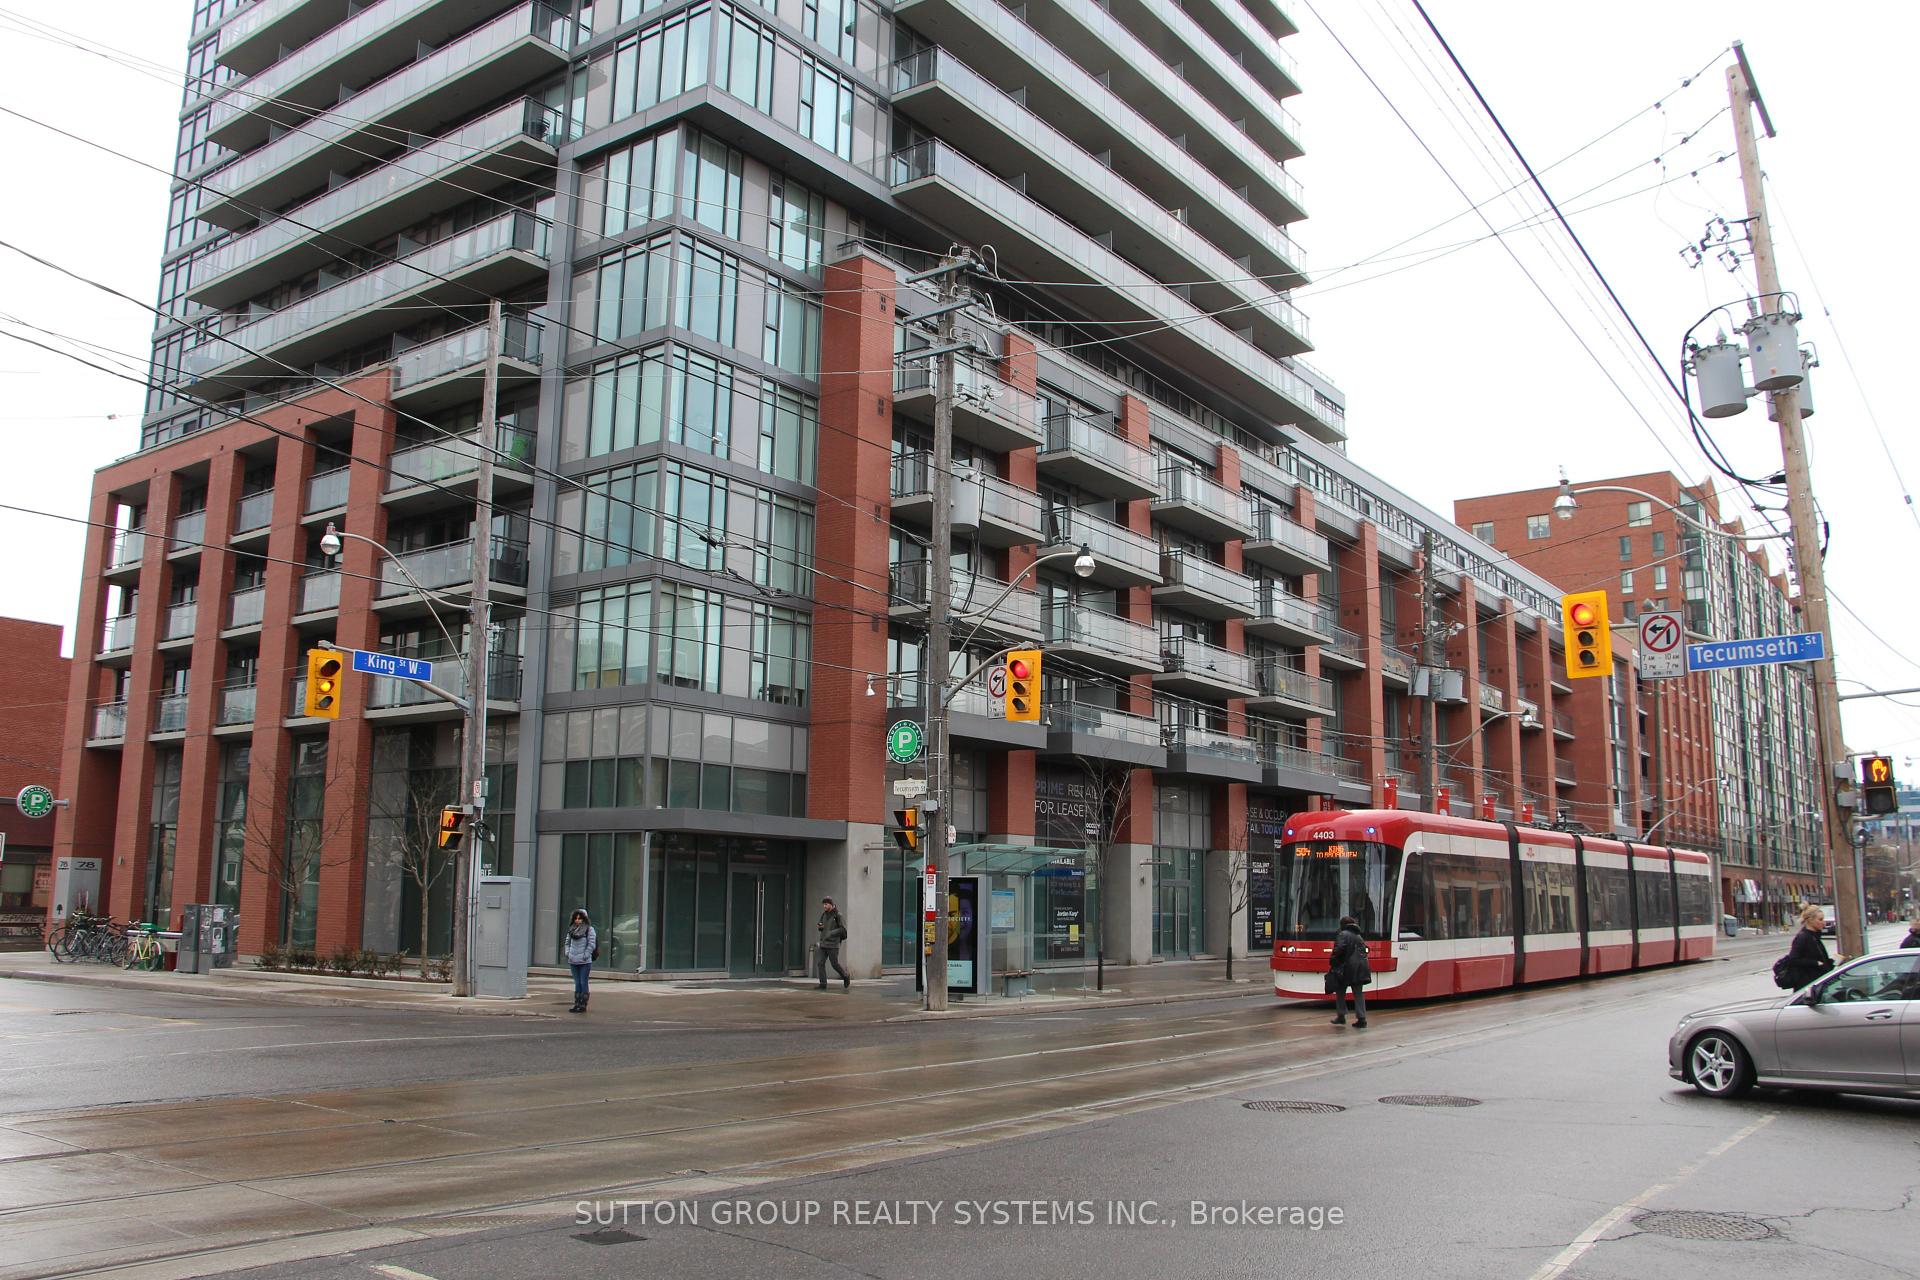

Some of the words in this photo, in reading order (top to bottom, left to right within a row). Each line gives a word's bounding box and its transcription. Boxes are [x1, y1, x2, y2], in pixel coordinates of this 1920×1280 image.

[1694, 638, 1798, 663] Tecumseth
[1804, 635, 1817, 645] St
[367, 654, 395, 674] King
[399, 659, 406, 667] St
[408, 661, 418, 674] W
[898, 731, 912, 749] P
[1035, 780, 1064, 795] PRIME
[31, 793, 43, 806] P
[1034, 800, 1054, 815] FOR
[1313, 831, 1334, 840] 4403
[77, 861, 96, 869] 78
